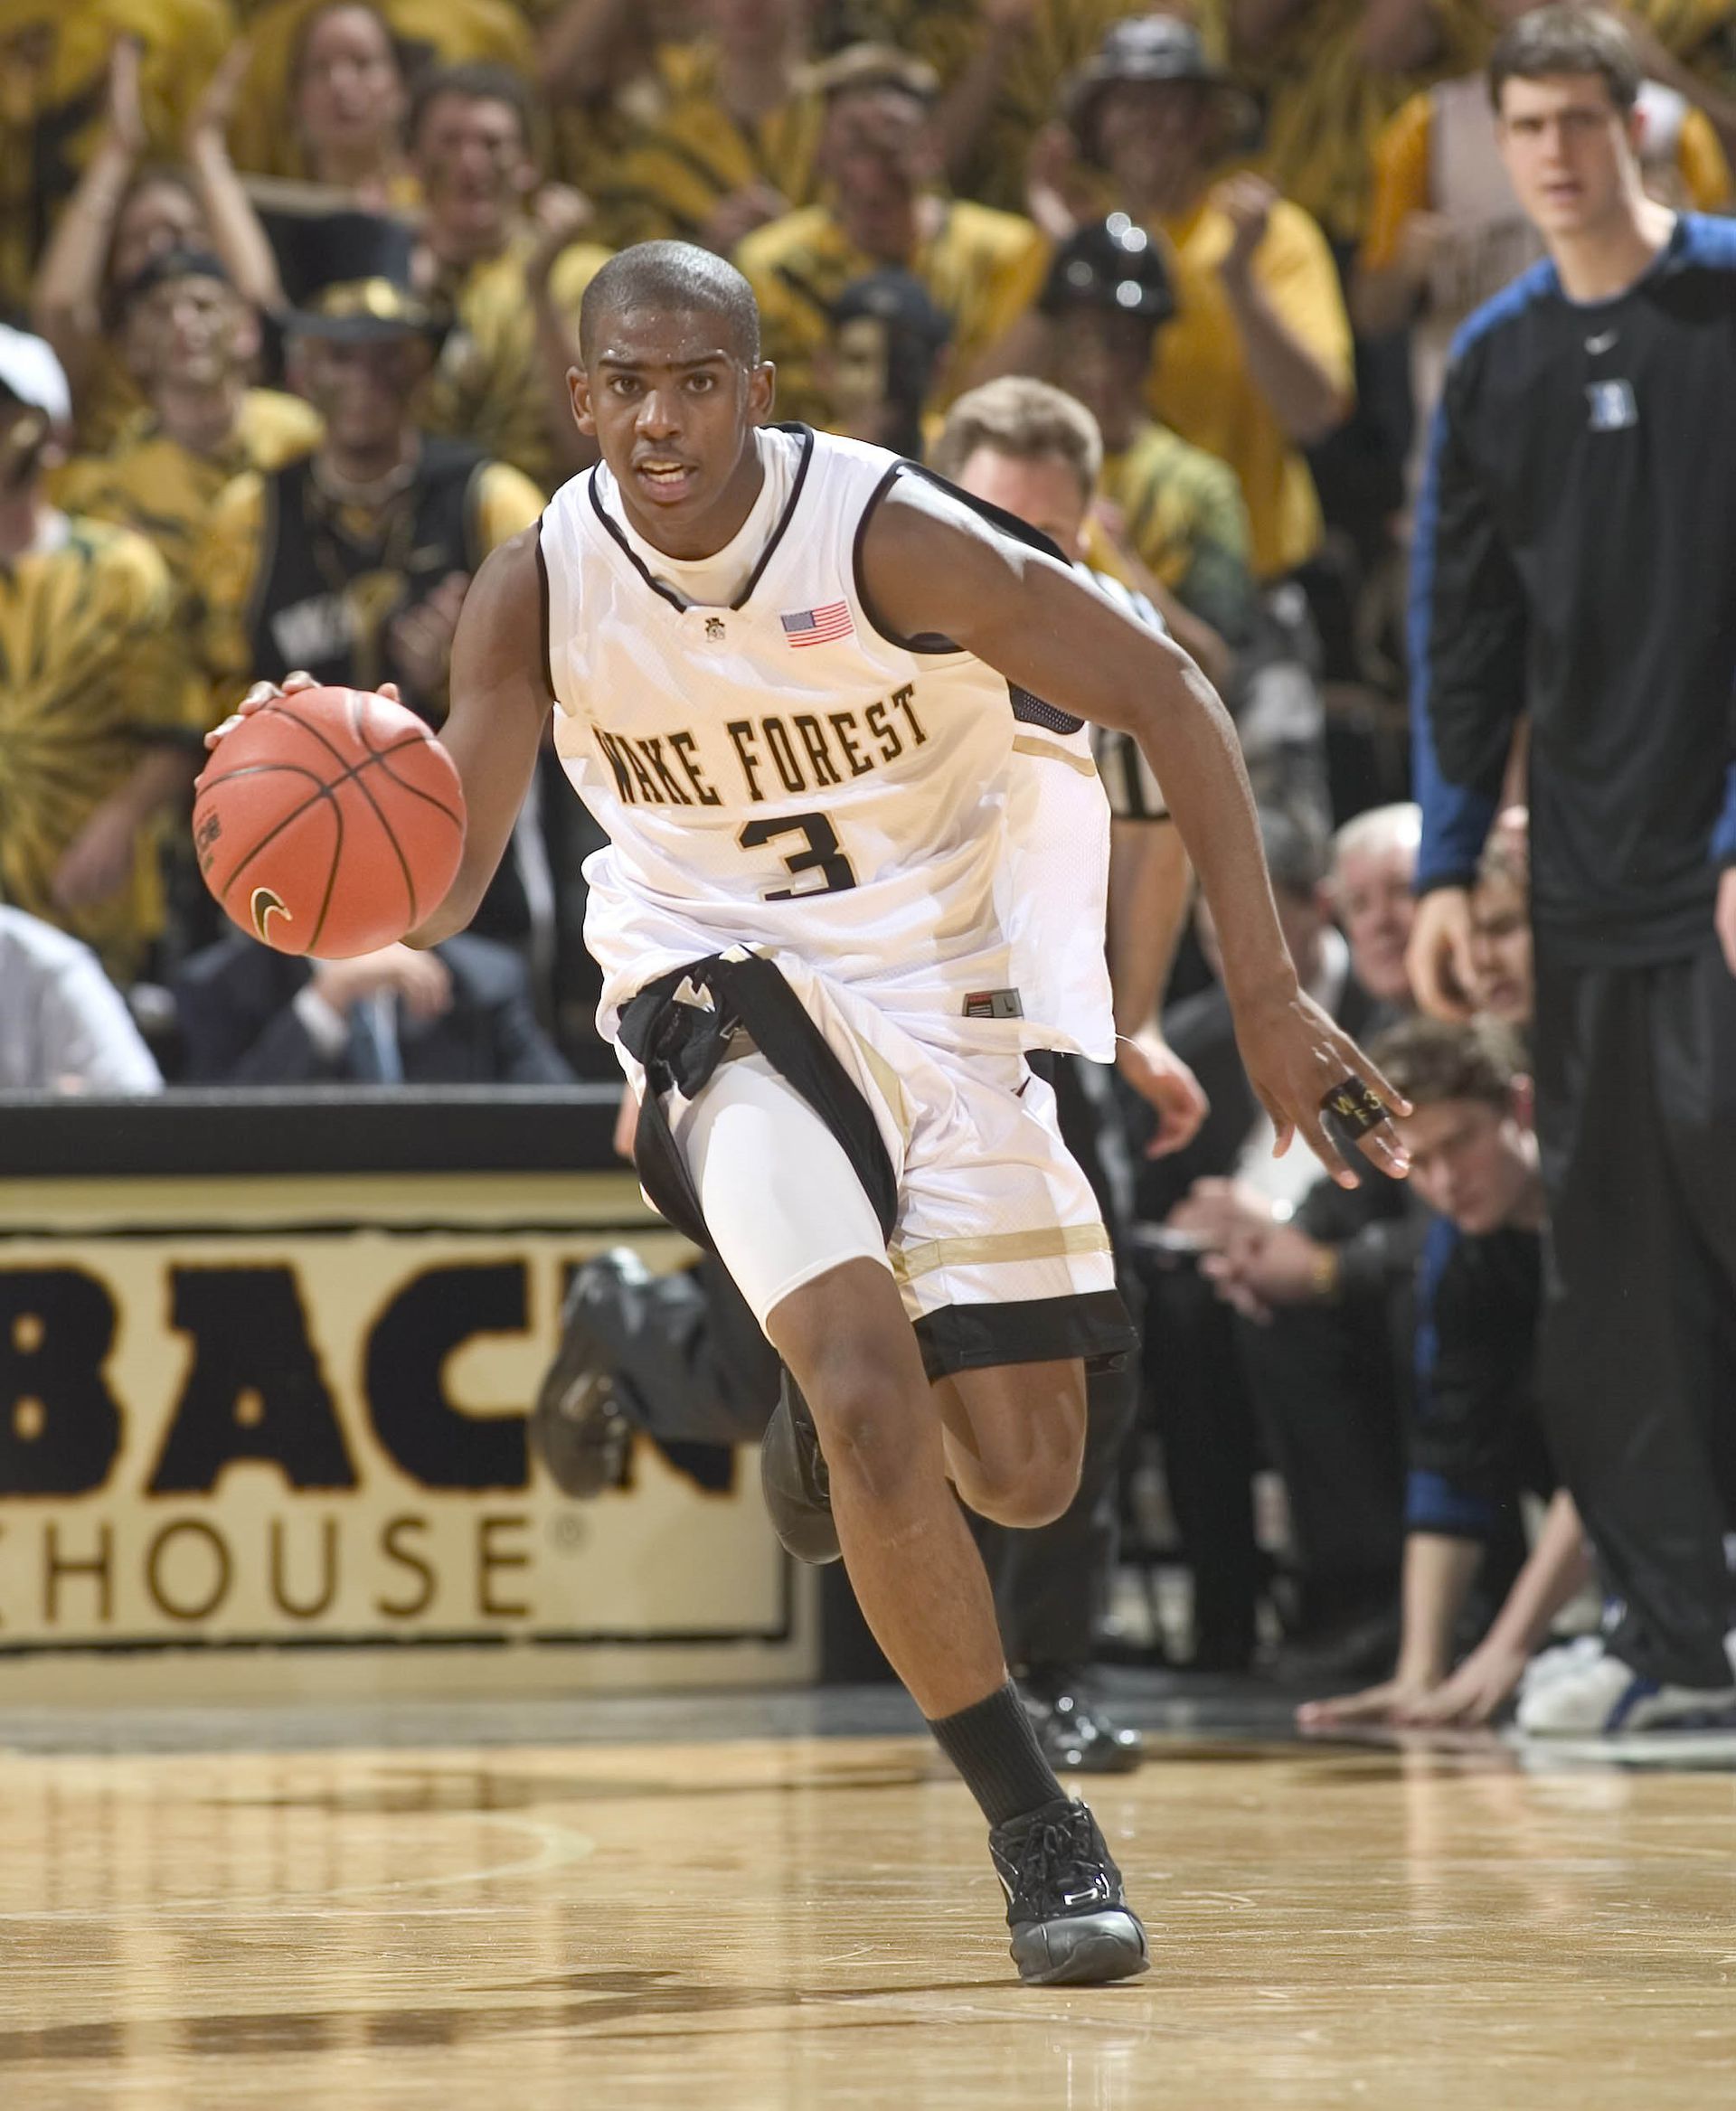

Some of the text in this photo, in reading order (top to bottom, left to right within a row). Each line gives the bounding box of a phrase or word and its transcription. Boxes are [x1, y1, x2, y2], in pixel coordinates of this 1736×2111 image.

[592, 683, 928, 806] WAKE FOREST
[735, 811, 859, 901] 3
[0, 1258, 740, 1496] BAC
[0, 1515, 533, 1624] HOUSE
